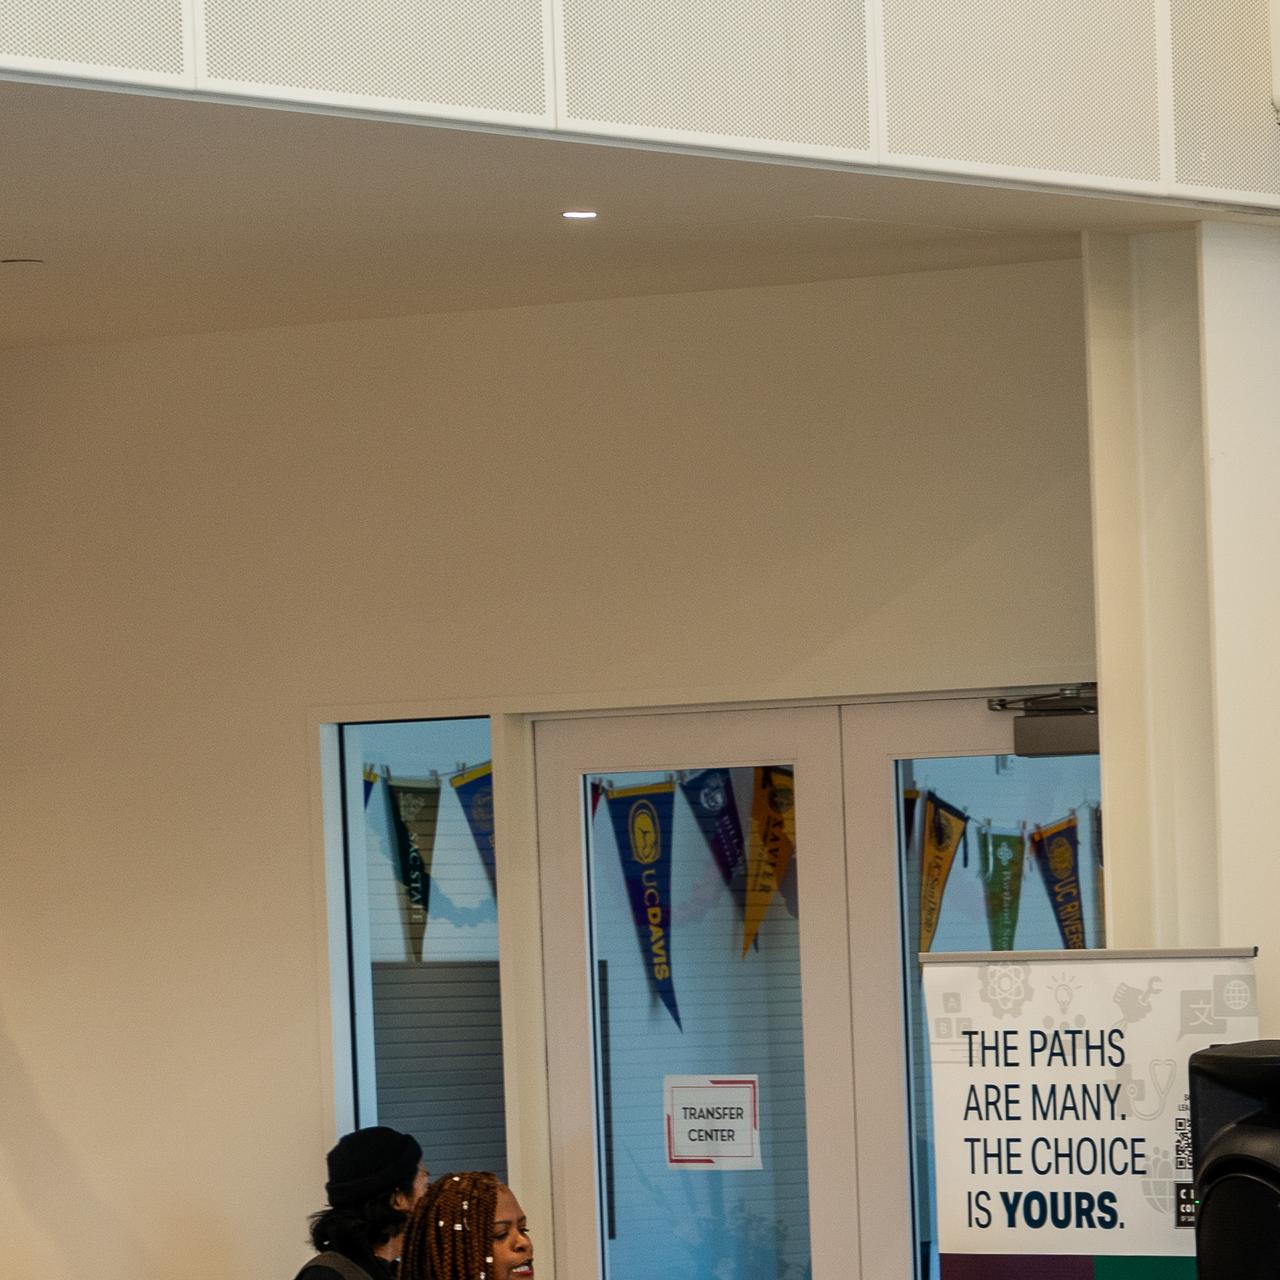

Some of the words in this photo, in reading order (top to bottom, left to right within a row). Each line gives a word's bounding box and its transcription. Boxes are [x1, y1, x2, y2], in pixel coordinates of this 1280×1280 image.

[1054, 876, 1077, 903] UC
[1058, 901, 1083, 949] RIVER
[961, 1030, 1019, 1068] THE
[1029, 1029, 1126, 1068] PATHS
[681, 1107, 744, 1120] TRANSFER
[963, 1083, 1022, 1121] ARE
[1031, 1083, 1127, 1121] MANY.
[688, 1129, 736, 1142] CENTER
[964, 1137, 1023, 1175] THE
[1031, 1137, 1147, 1176] CHOICE
[967, 1190, 992, 1228] IS
[1000, 1190, 1125, 1229] YOURS.
